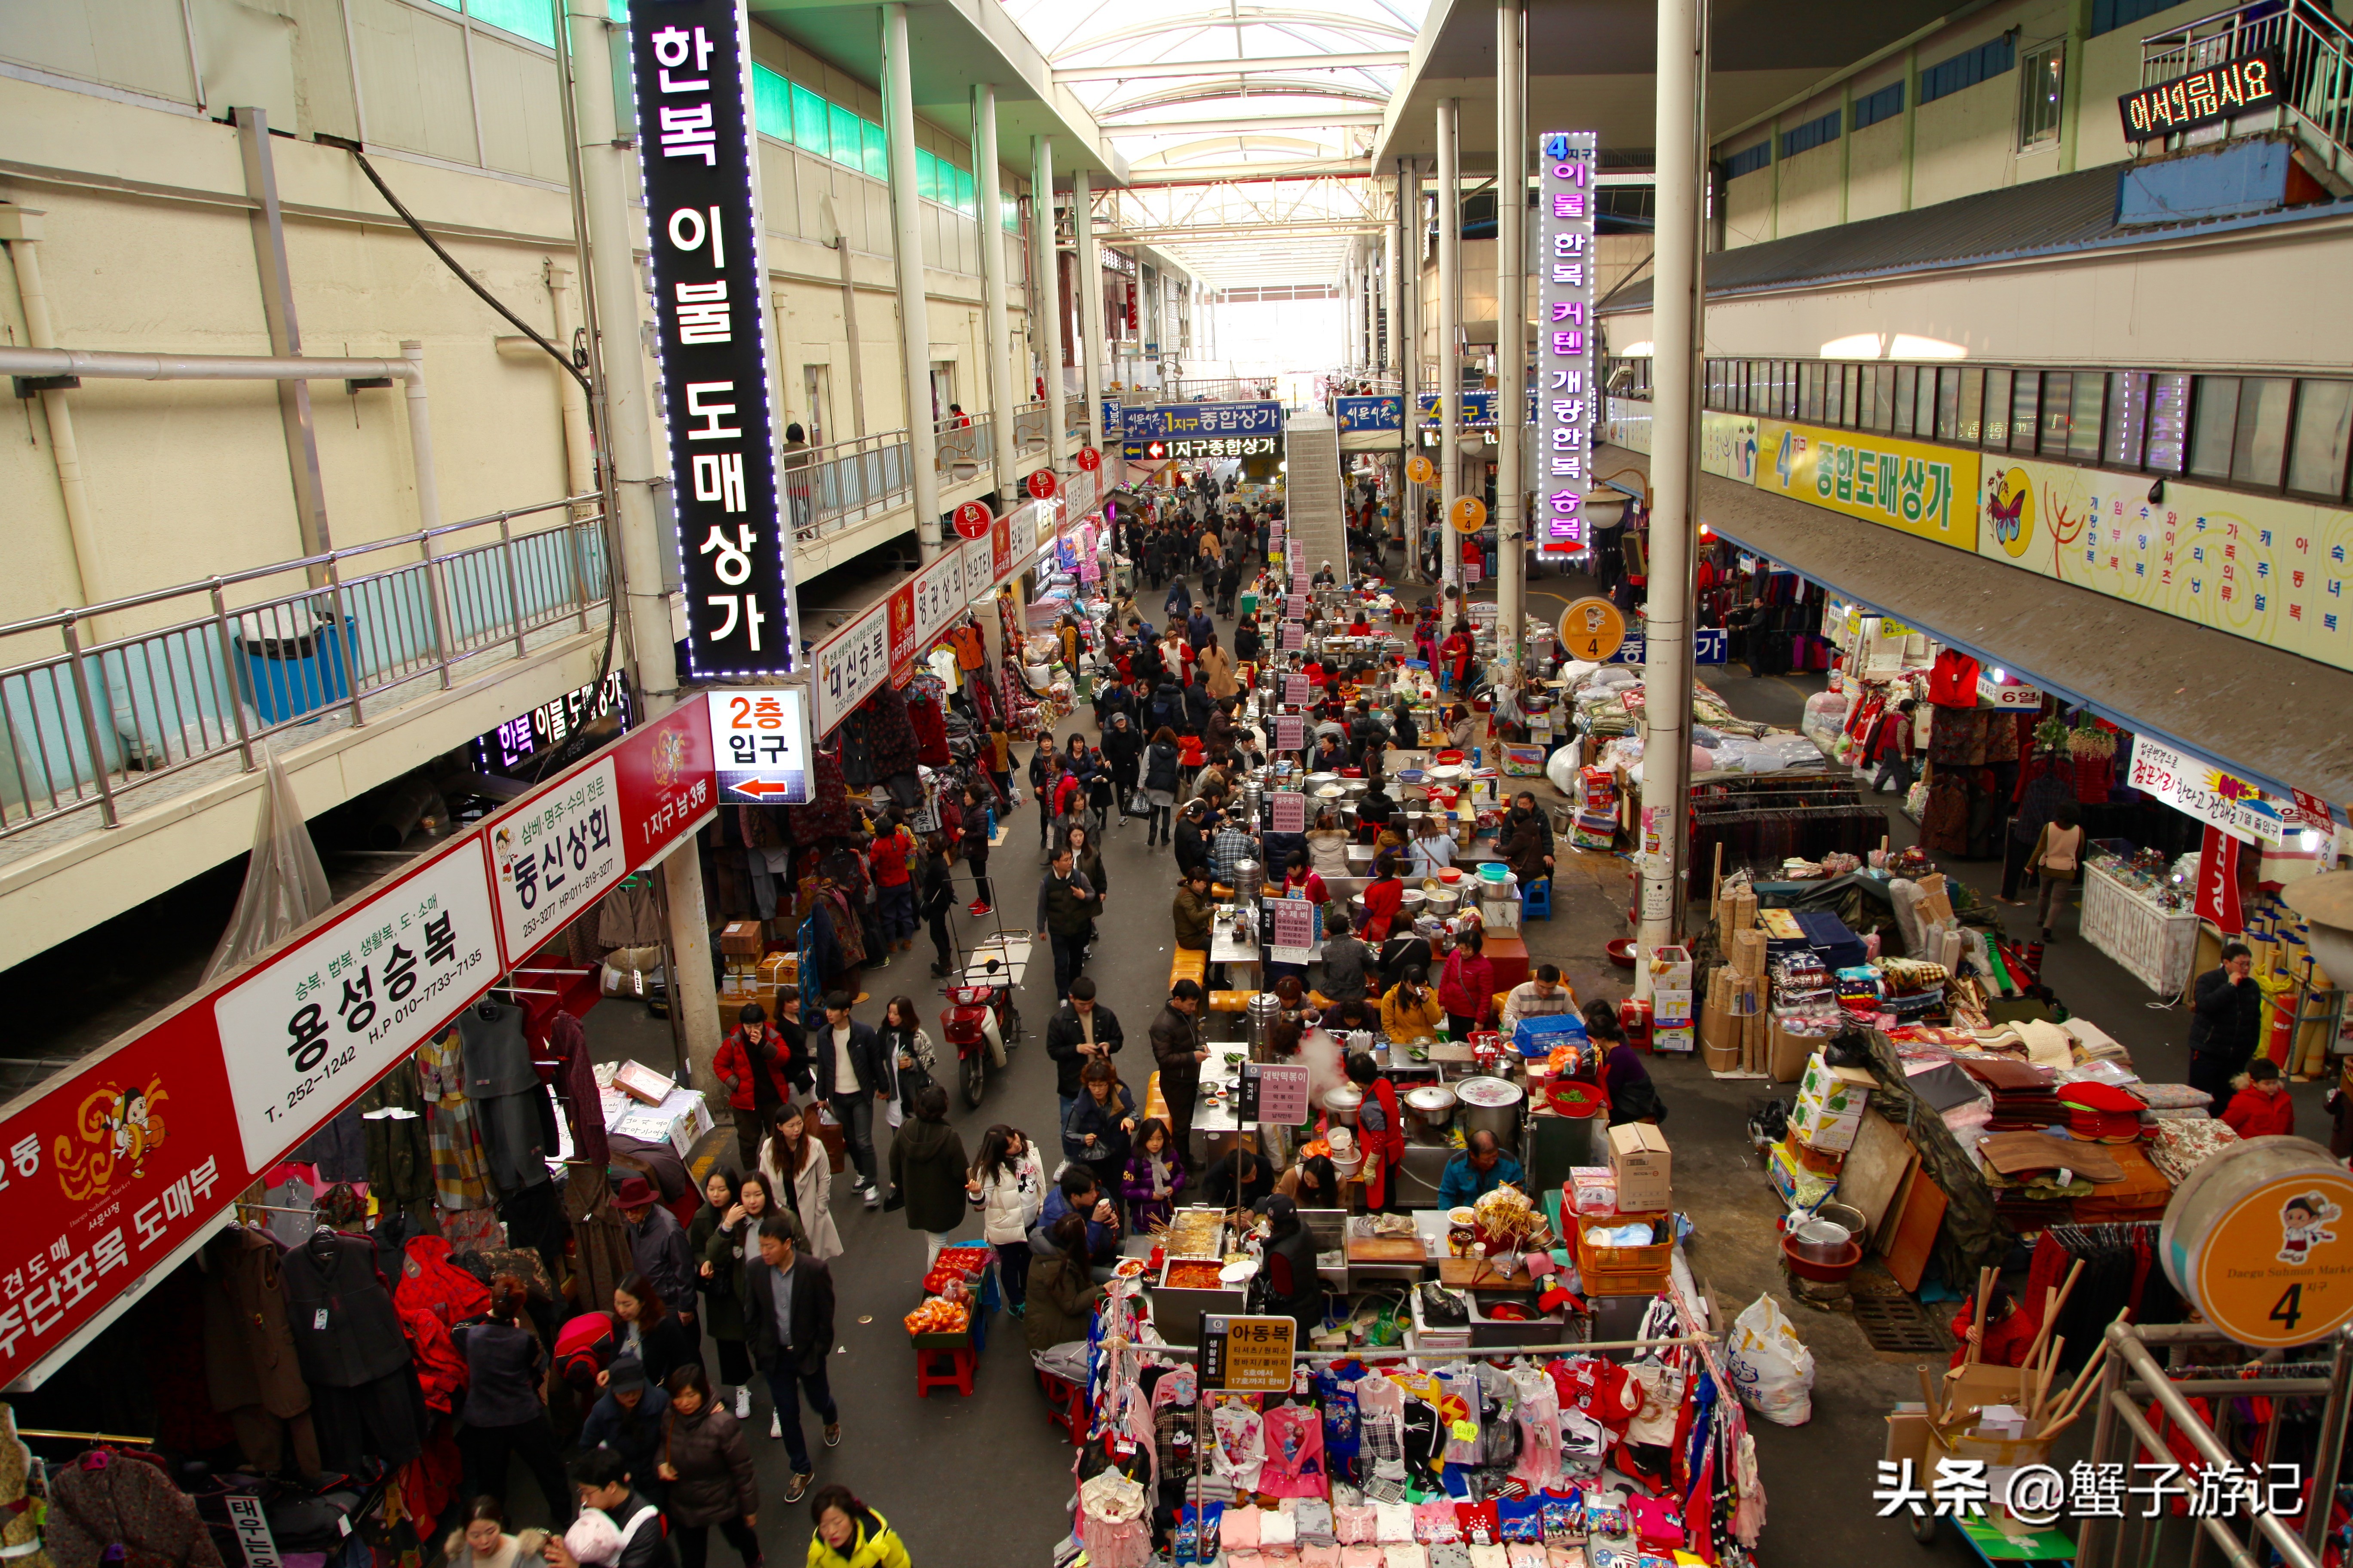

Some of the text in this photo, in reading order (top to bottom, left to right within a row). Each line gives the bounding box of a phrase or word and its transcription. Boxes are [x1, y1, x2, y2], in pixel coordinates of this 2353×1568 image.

[1552, 162, 1586, 218] 이불
[1550, 232, 1586, 287] 한복
[652, 26, 764, 651] 한복 이불 도매상가
[1550, 302, 1585, 356] 커텐
[1128, 410, 1277, 432] 서문시장 1지구 종합상가
[1347, 406, 1391, 427] 서문시장
[1550, 370, 1585, 480] 개량한복
[1166, 438, 1276, 457] 1지구종합상가
[1816, 441, 1952, 531] 종합도매상가
[1465, 520, 1471, 530] 4
[1549, 489, 1581, 540] 승복
[2086, 496, 2099, 565] 개량한복
[2110, 501, 2123, 571] 임부복
[2135, 506, 2149, 577] 수영복
[967, 549, 991, 588] 천우TEX
[2163, 511, 2178, 585] 와이셔츠
[2191, 517, 2206, 594] 추리닝
[2221, 523, 2239, 602] 가죽의류
[2255, 529, 2273, 612] 캐주얼
[919, 567, 960, 625] 영광상회
[2289, 536, 2310, 622] 아동복
[2324, 544, 2345, 633] 숙녀복
[830, 629, 882, 700] 대신승복
[1588, 639, 1598, 655] 4
[1620, 638, 1721, 664] 종가
[2002, 691, 2036, 703] 6열
[497, 714, 534, 767] 한복
[535, 697, 567, 744] 이불
[729, 696, 788, 764] 2층 입구
[587, 776, 605, 802] 전문
[676, 792, 688, 818] 남
[690, 778, 707, 809] 3동
[2239, 810, 2278, 837] 7열 출입구
[514, 804, 610, 910] 동신상회
[523, 858, 613, 938] 253-3277 HP:011-819-3277
[1295, 903, 1309, 911] 엄마
[287, 909, 457, 1073] 용성승복
[287, 1045, 356, 1110] 252-1242
[368, 1018, 392, 1045] H.P
[395, 948, 483, 1024] 010-7733-7135
[1263, 1071, 1306, 1082] 대박떡볶이
[89, 1201, 120, 1231] 서문시장
[133, 1154, 220, 1251] 도매부
[2227, 1266, 2353, 1279] Daegu Suhmun Marke
[1233, 1325, 1290, 1342] 아동복
[2269, 1281, 2328, 1330] 4 지구
[1208, 1340, 1218, 1375] 생활용품
